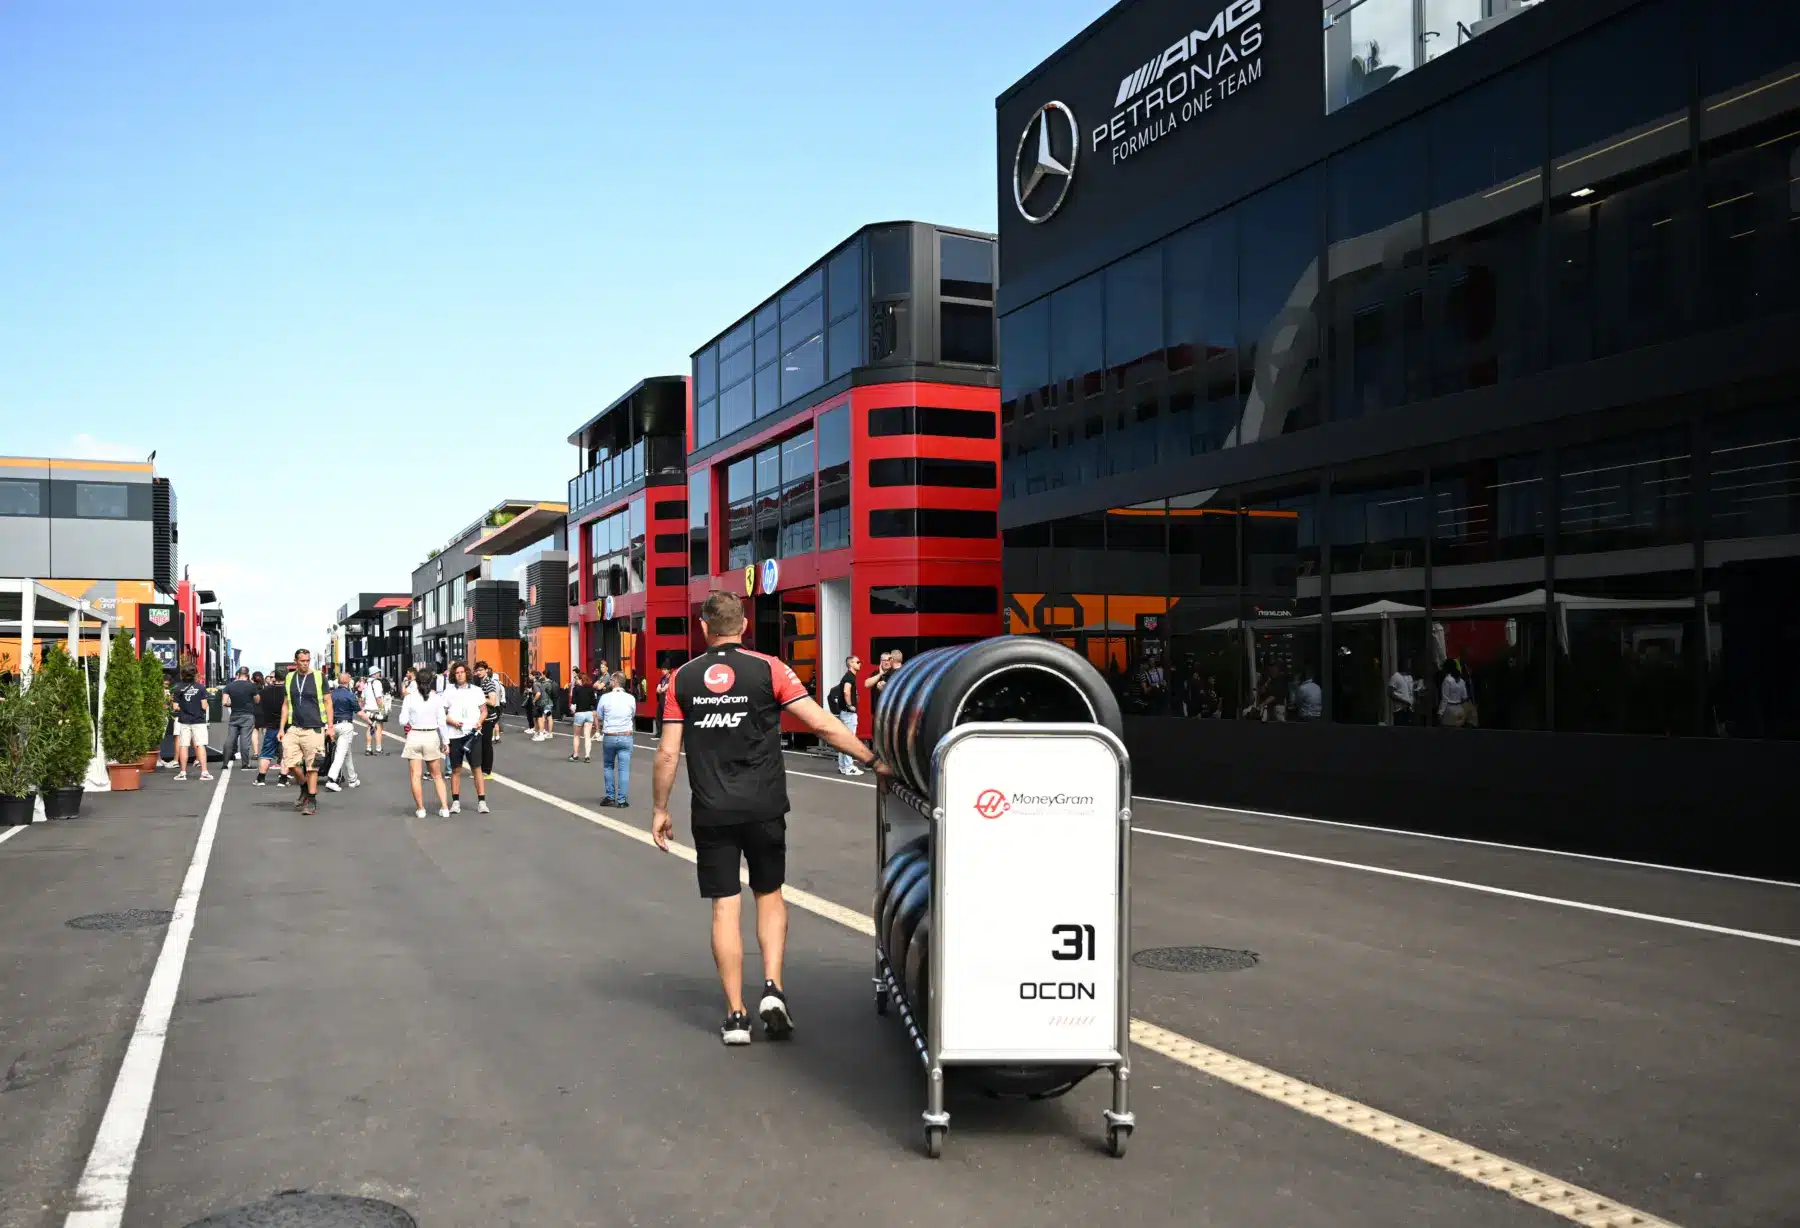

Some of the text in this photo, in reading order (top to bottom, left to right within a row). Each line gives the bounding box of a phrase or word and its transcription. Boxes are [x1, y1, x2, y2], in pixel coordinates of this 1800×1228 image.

[1156, 0, 1261, 80] AMG
[1092, 22, 1263, 152] PETRONAS
[1112, 58, 1262, 165] FORMULA ONE TEAM
[692, 695, 748, 706] MoneyGram
[694, 712, 748, 728] HAAS
[1012, 793, 1094, 807] MoneyGram
[1051, 924, 1095, 961] 31
[1020, 982, 1095, 1000] OCON
